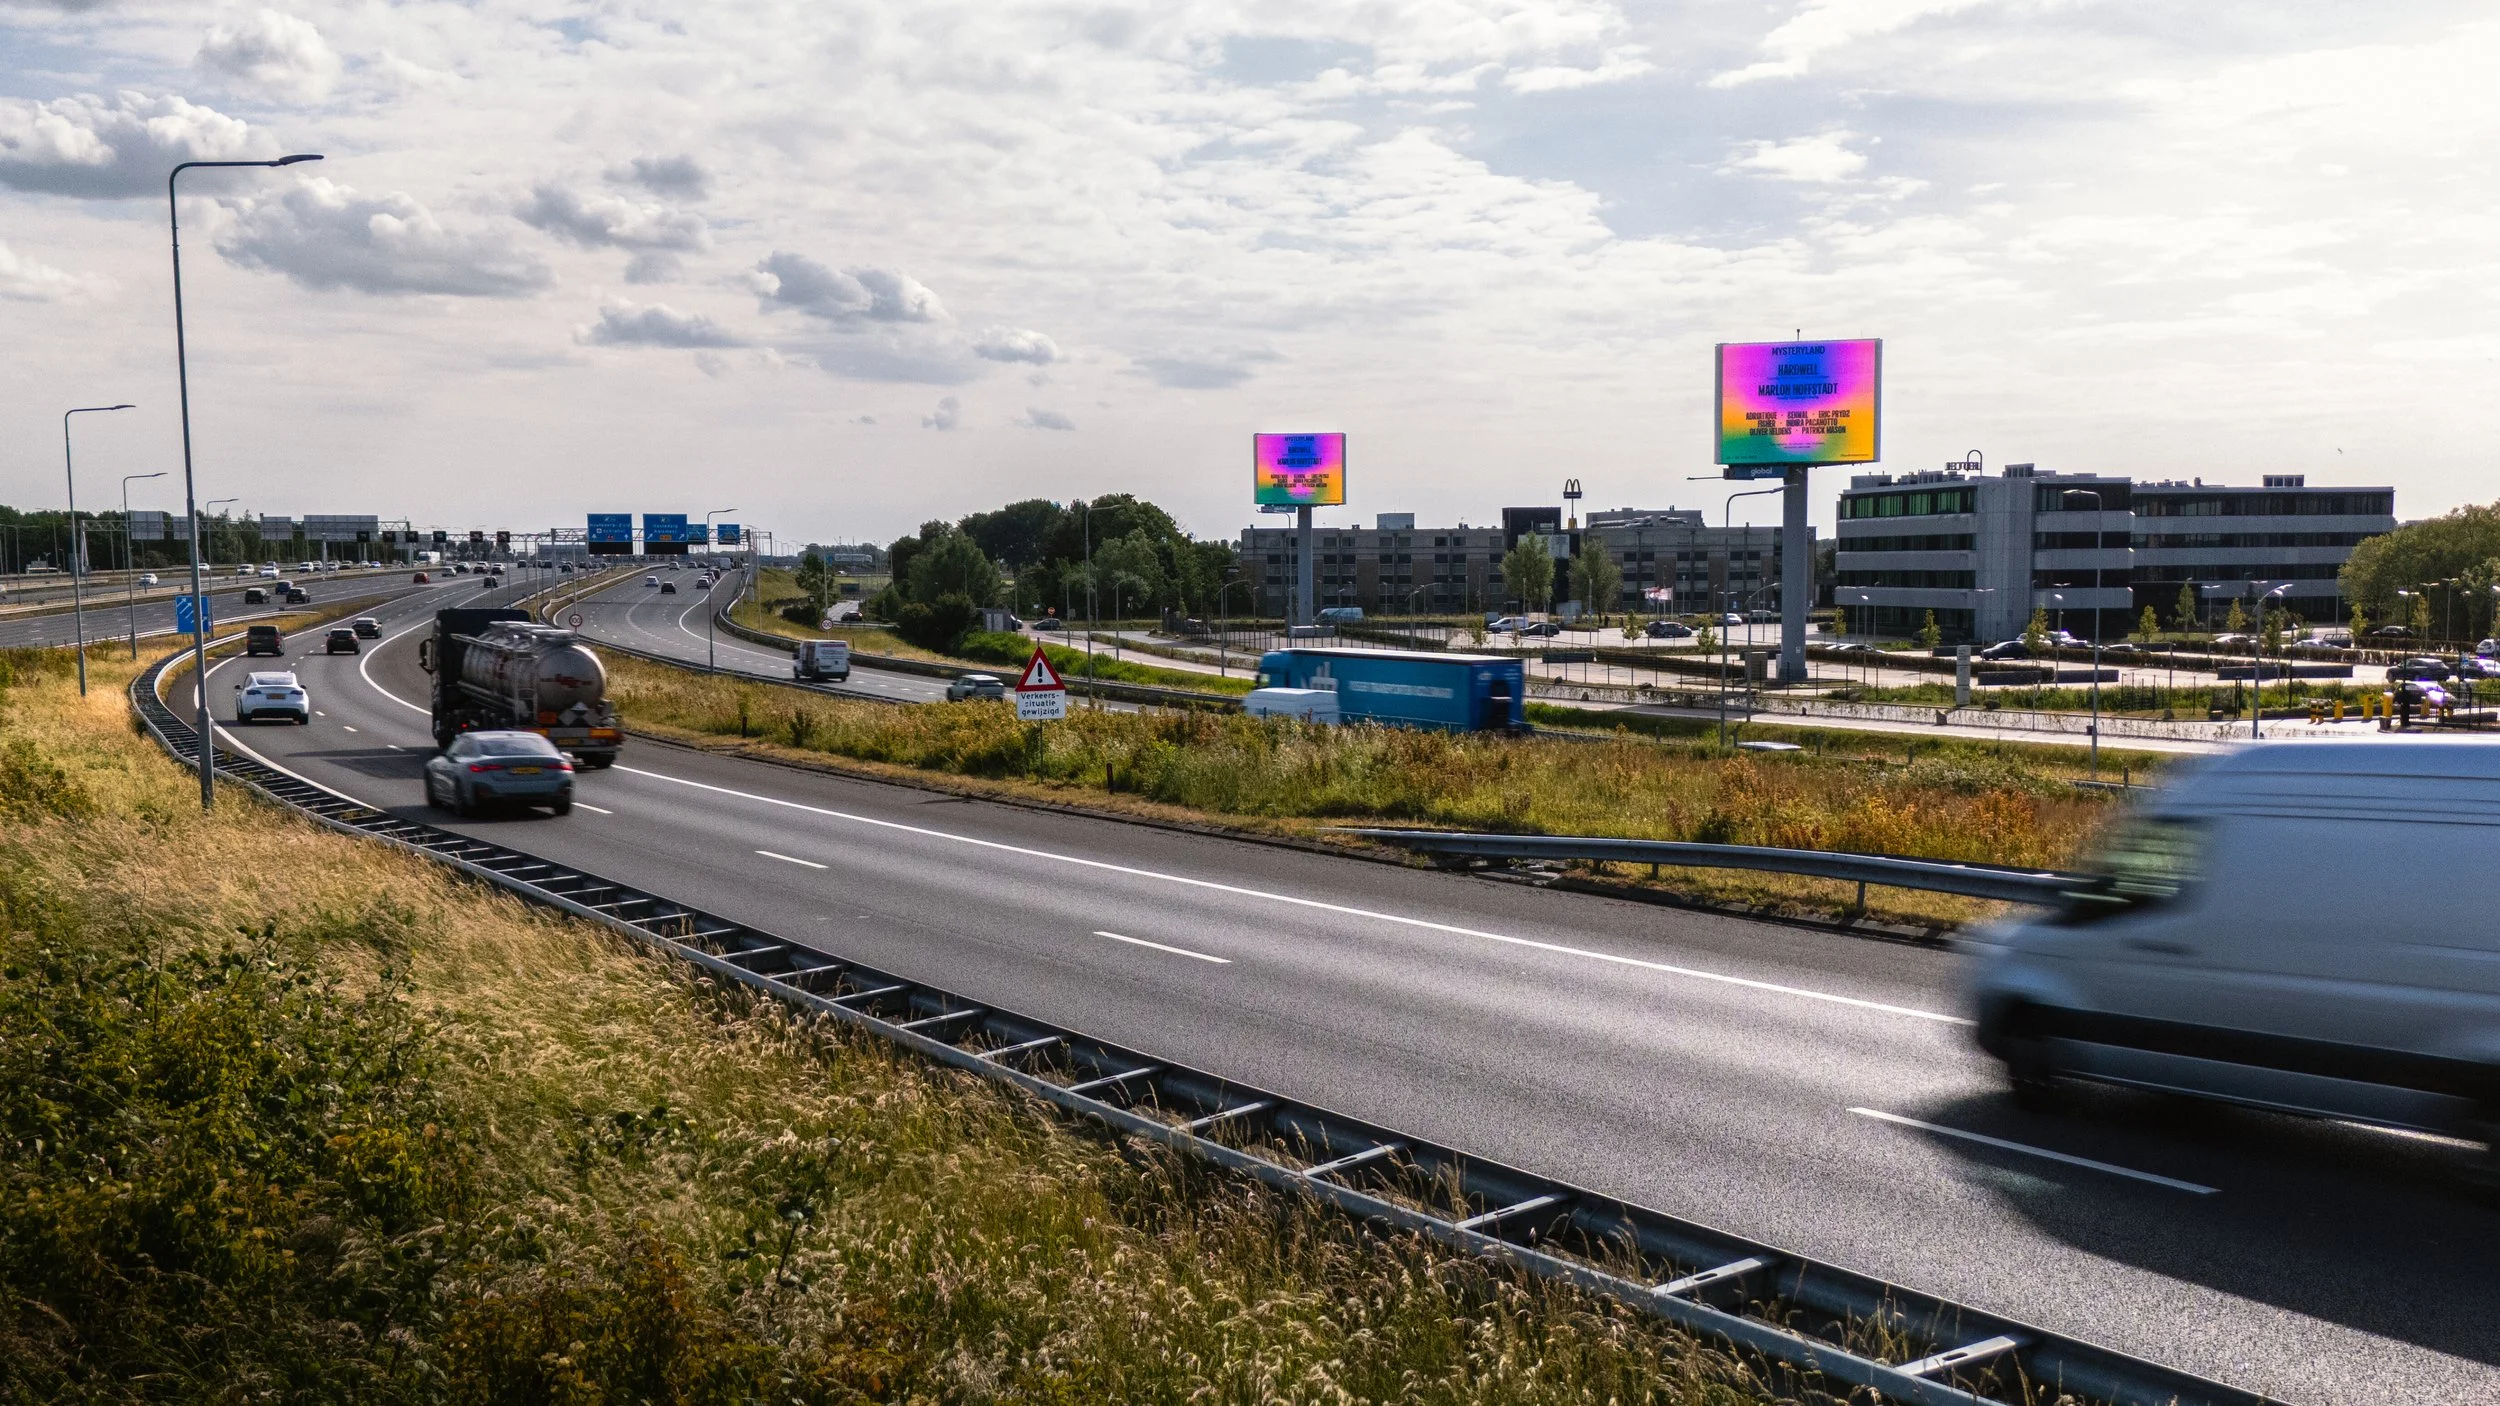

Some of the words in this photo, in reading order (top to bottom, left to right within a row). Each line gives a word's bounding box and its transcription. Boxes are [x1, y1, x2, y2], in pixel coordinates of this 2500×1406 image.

[1772, 346, 1825, 356] MYSTERYLAND
[1778, 364, 1817, 376] HARDWELL
[1758, 384, 1791, 396] MARLON
[1793, 382, 1838, 395] HOFFSTADT
[1750, 467, 1773, 477] global
[1021, 692, 1060, 700] Verkeers-
[1021, 708, 1060, 717] gewijzigd
